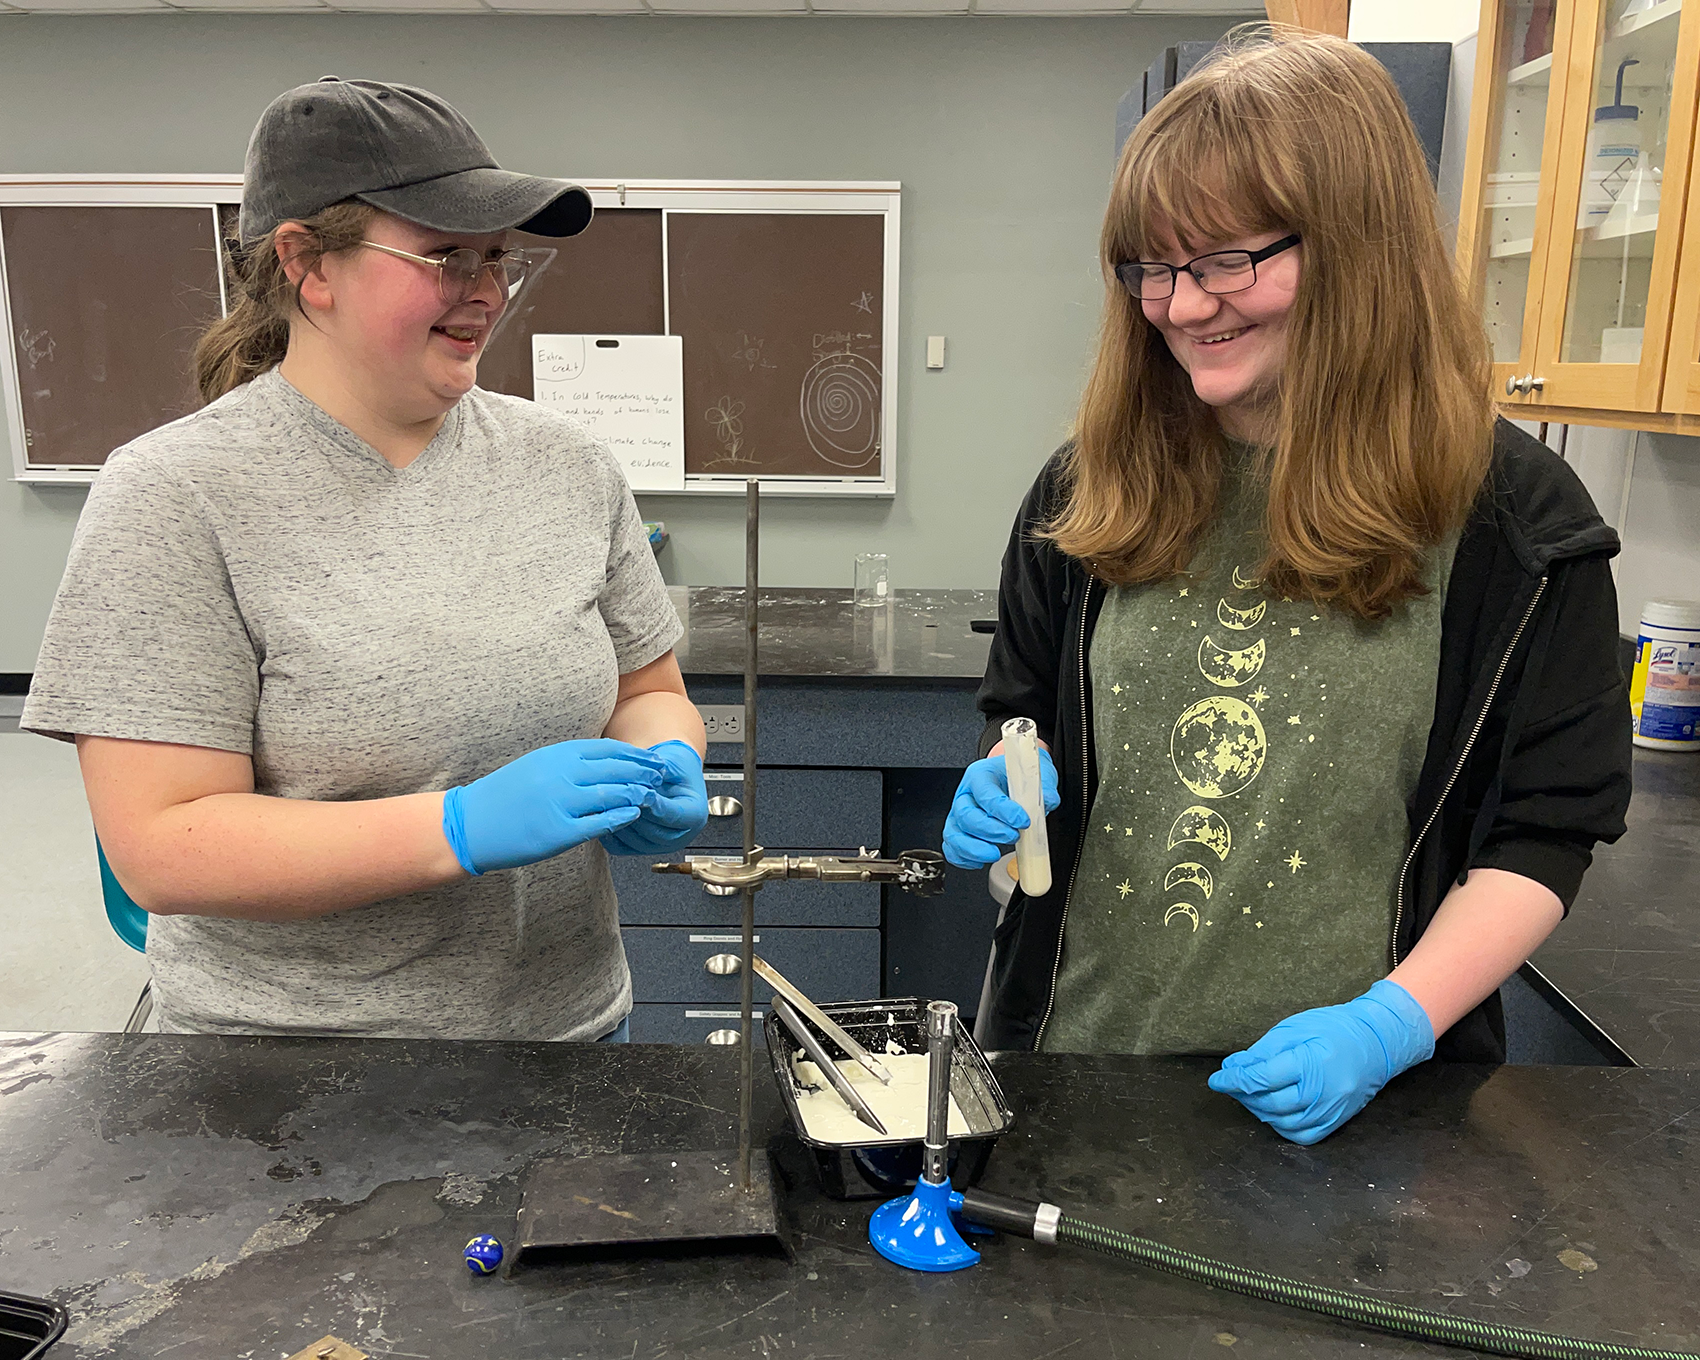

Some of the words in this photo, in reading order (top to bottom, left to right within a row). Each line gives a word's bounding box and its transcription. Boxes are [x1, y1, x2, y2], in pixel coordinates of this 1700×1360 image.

[538, 349, 564, 363] Extra
[552, 362, 578, 372] credit
[552, 390, 564, 401] In
[583, 407, 604, 415] hands
[1653, 646, 1678, 660] Lysol
